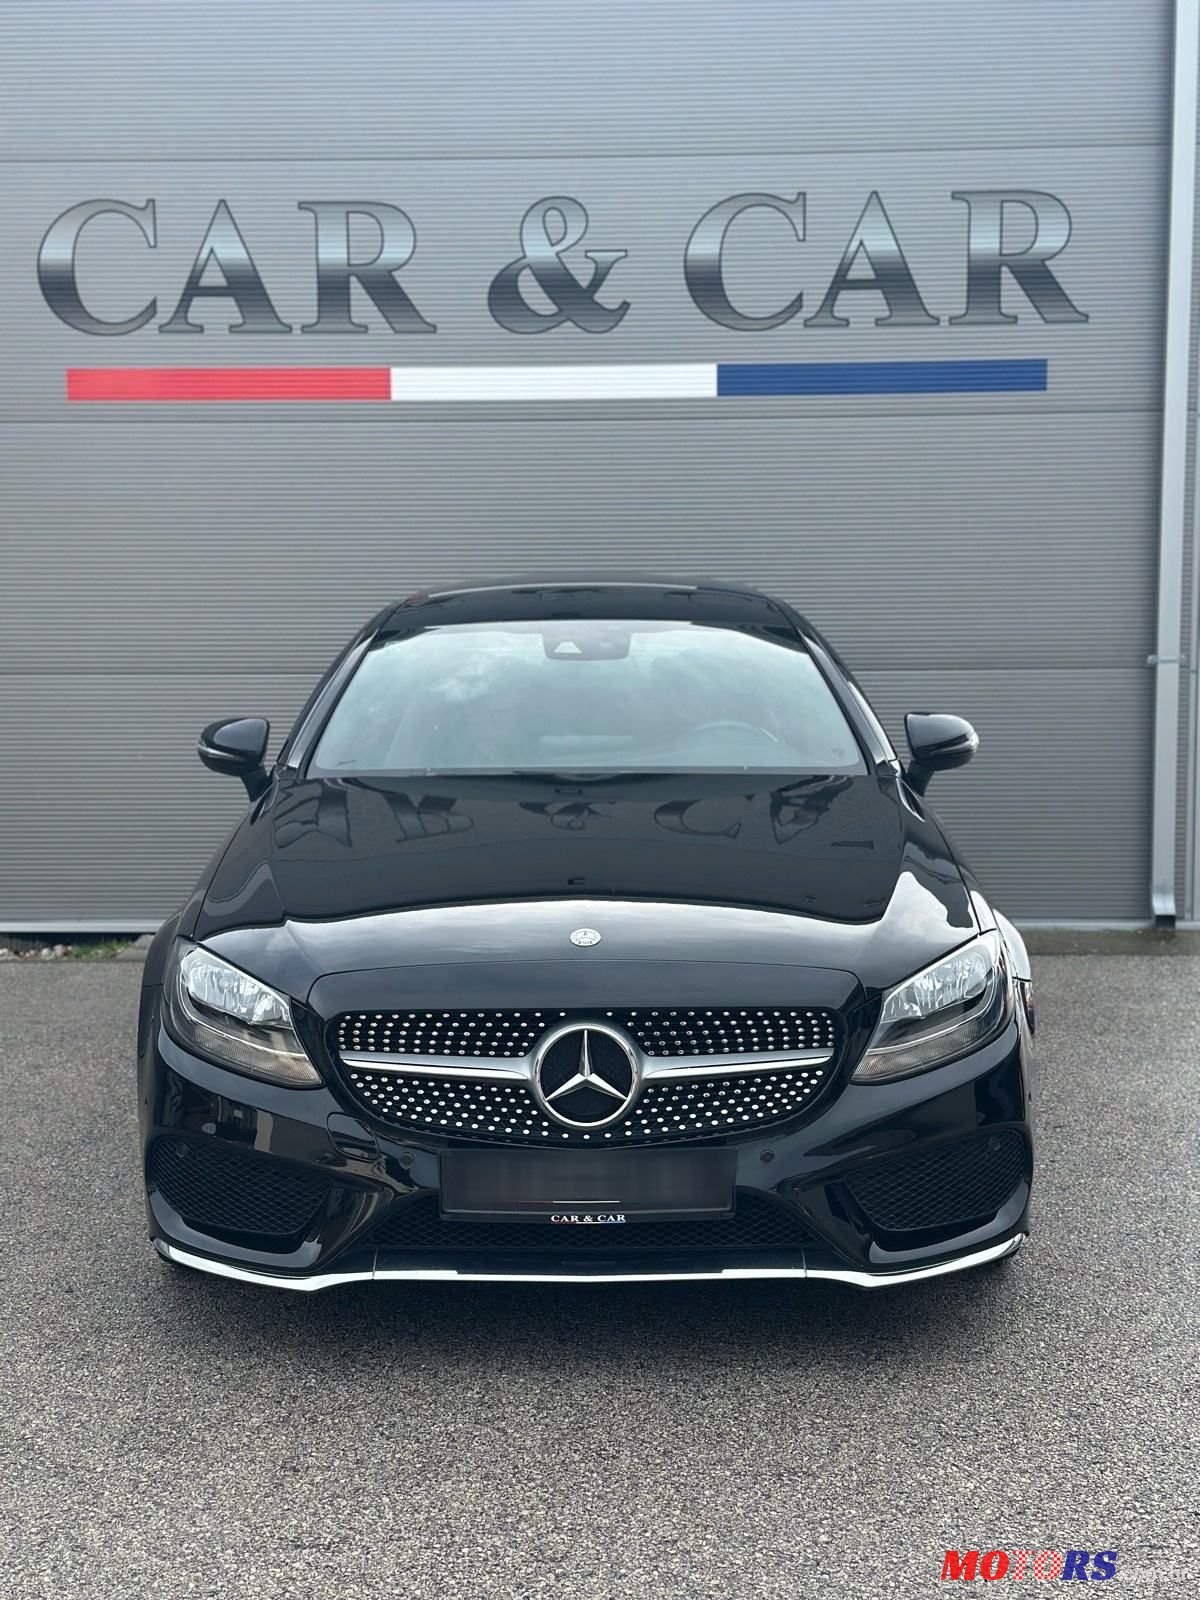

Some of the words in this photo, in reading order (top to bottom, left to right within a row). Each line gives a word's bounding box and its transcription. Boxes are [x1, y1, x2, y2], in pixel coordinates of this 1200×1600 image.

[37, 198, 437, 336] CAR
[487, 195, 631, 335] &
[684, 189, 1089, 331] CAR
[550, 1214, 579, 1223] CAR
[583, 1214, 593, 1223] &
[597, 1214, 626, 1223] CAR
